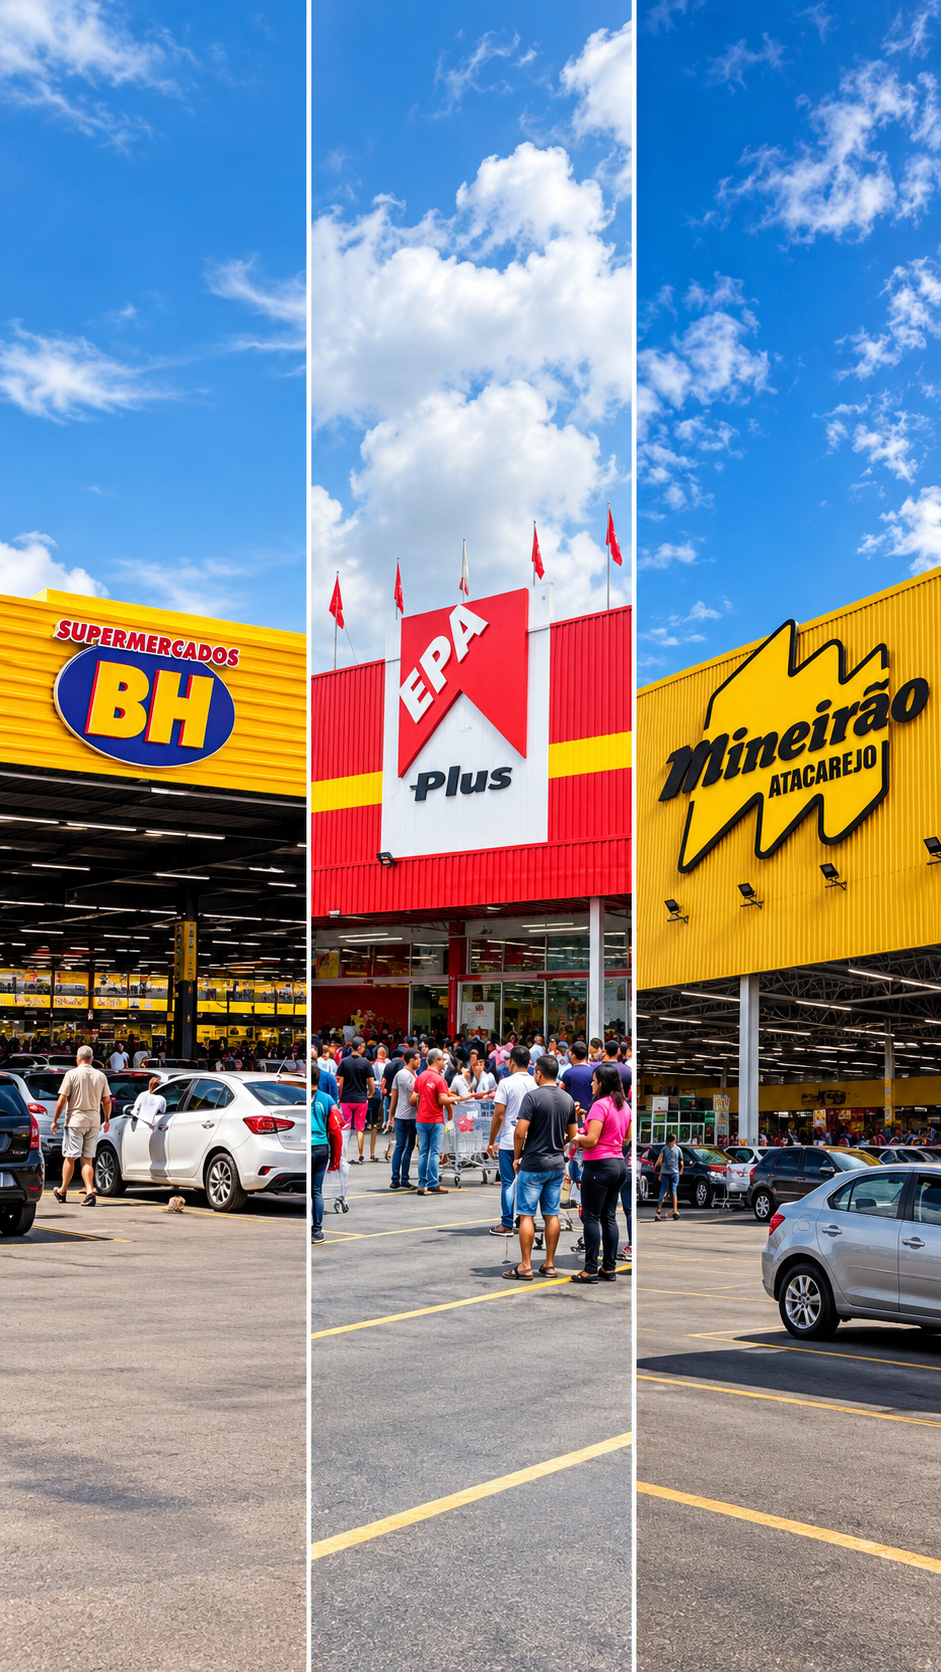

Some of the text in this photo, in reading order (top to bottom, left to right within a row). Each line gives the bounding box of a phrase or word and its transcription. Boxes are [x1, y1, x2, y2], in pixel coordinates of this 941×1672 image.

[55, 619, 240, 667] SUPERMERCADOS
[399, 604, 490, 724] EPA
[84, 659, 215, 749] BH
[658, 677, 930, 802] Mineirão
[410, 765, 513, 802] Plus
[768, 745, 877, 799] ATACAREJO
